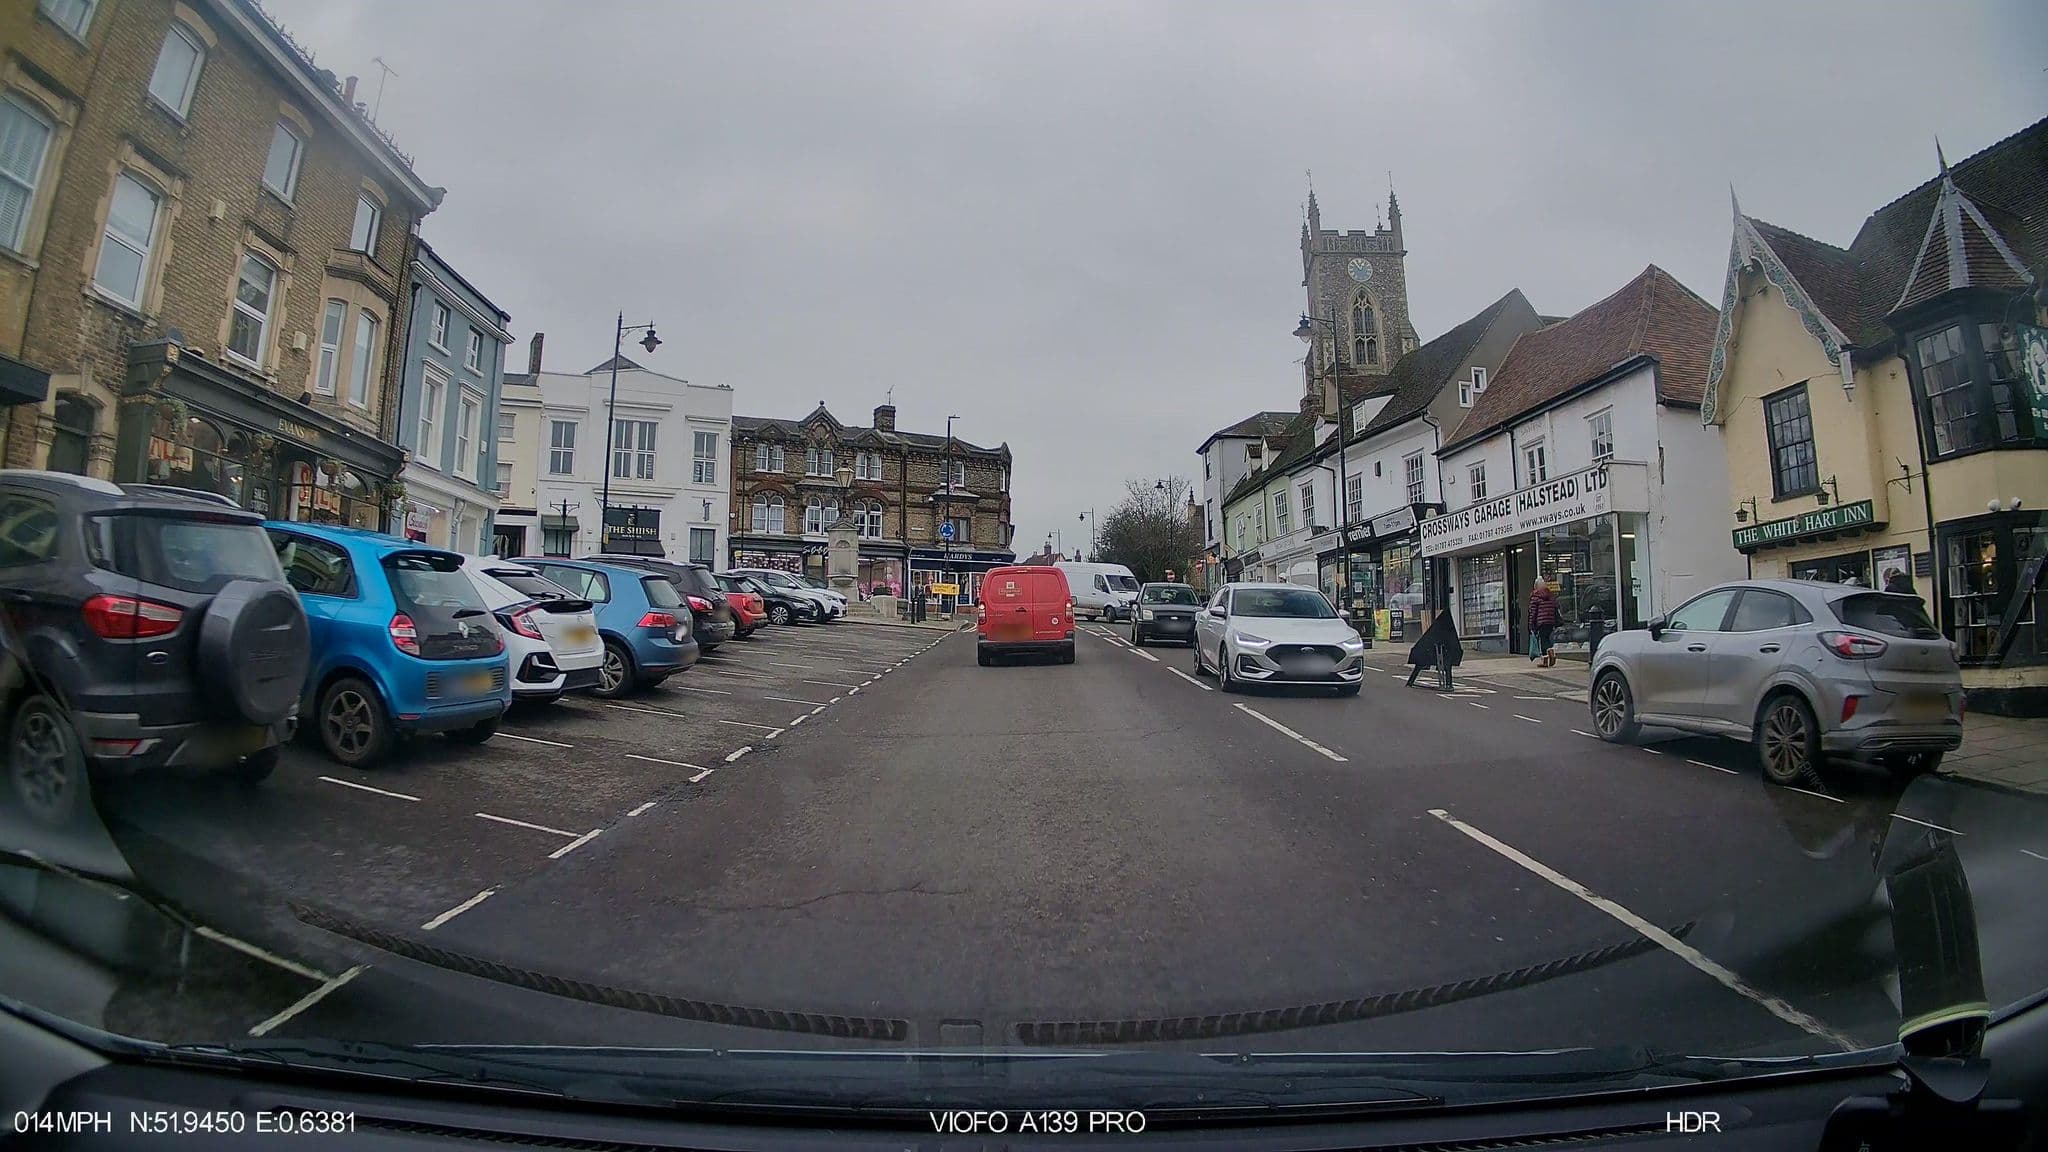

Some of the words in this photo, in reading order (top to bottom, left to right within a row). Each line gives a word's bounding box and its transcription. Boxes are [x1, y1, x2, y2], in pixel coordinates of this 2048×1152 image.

[278, 418, 304, 439] EVANS
[1422, 511, 1470, 539] CROSSWAYS
[1474, 498, 1511, 524] GARAGE
[1515, 477, 1579, 517] (HALSTEAD)
[1585, 469, 1607, 493] LTD
[1519, 502, 1586, 531] www.xways.co.uk
[608, 525, 625, 534] THE
[1347, 526, 1371, 542] remier
[1736, 527, 1759, 545] THE
[1762, 518, 1801, 539] WHITE
[1805, 510, 1838, 531] HART
[1844, 503, 1868, 523] INN
